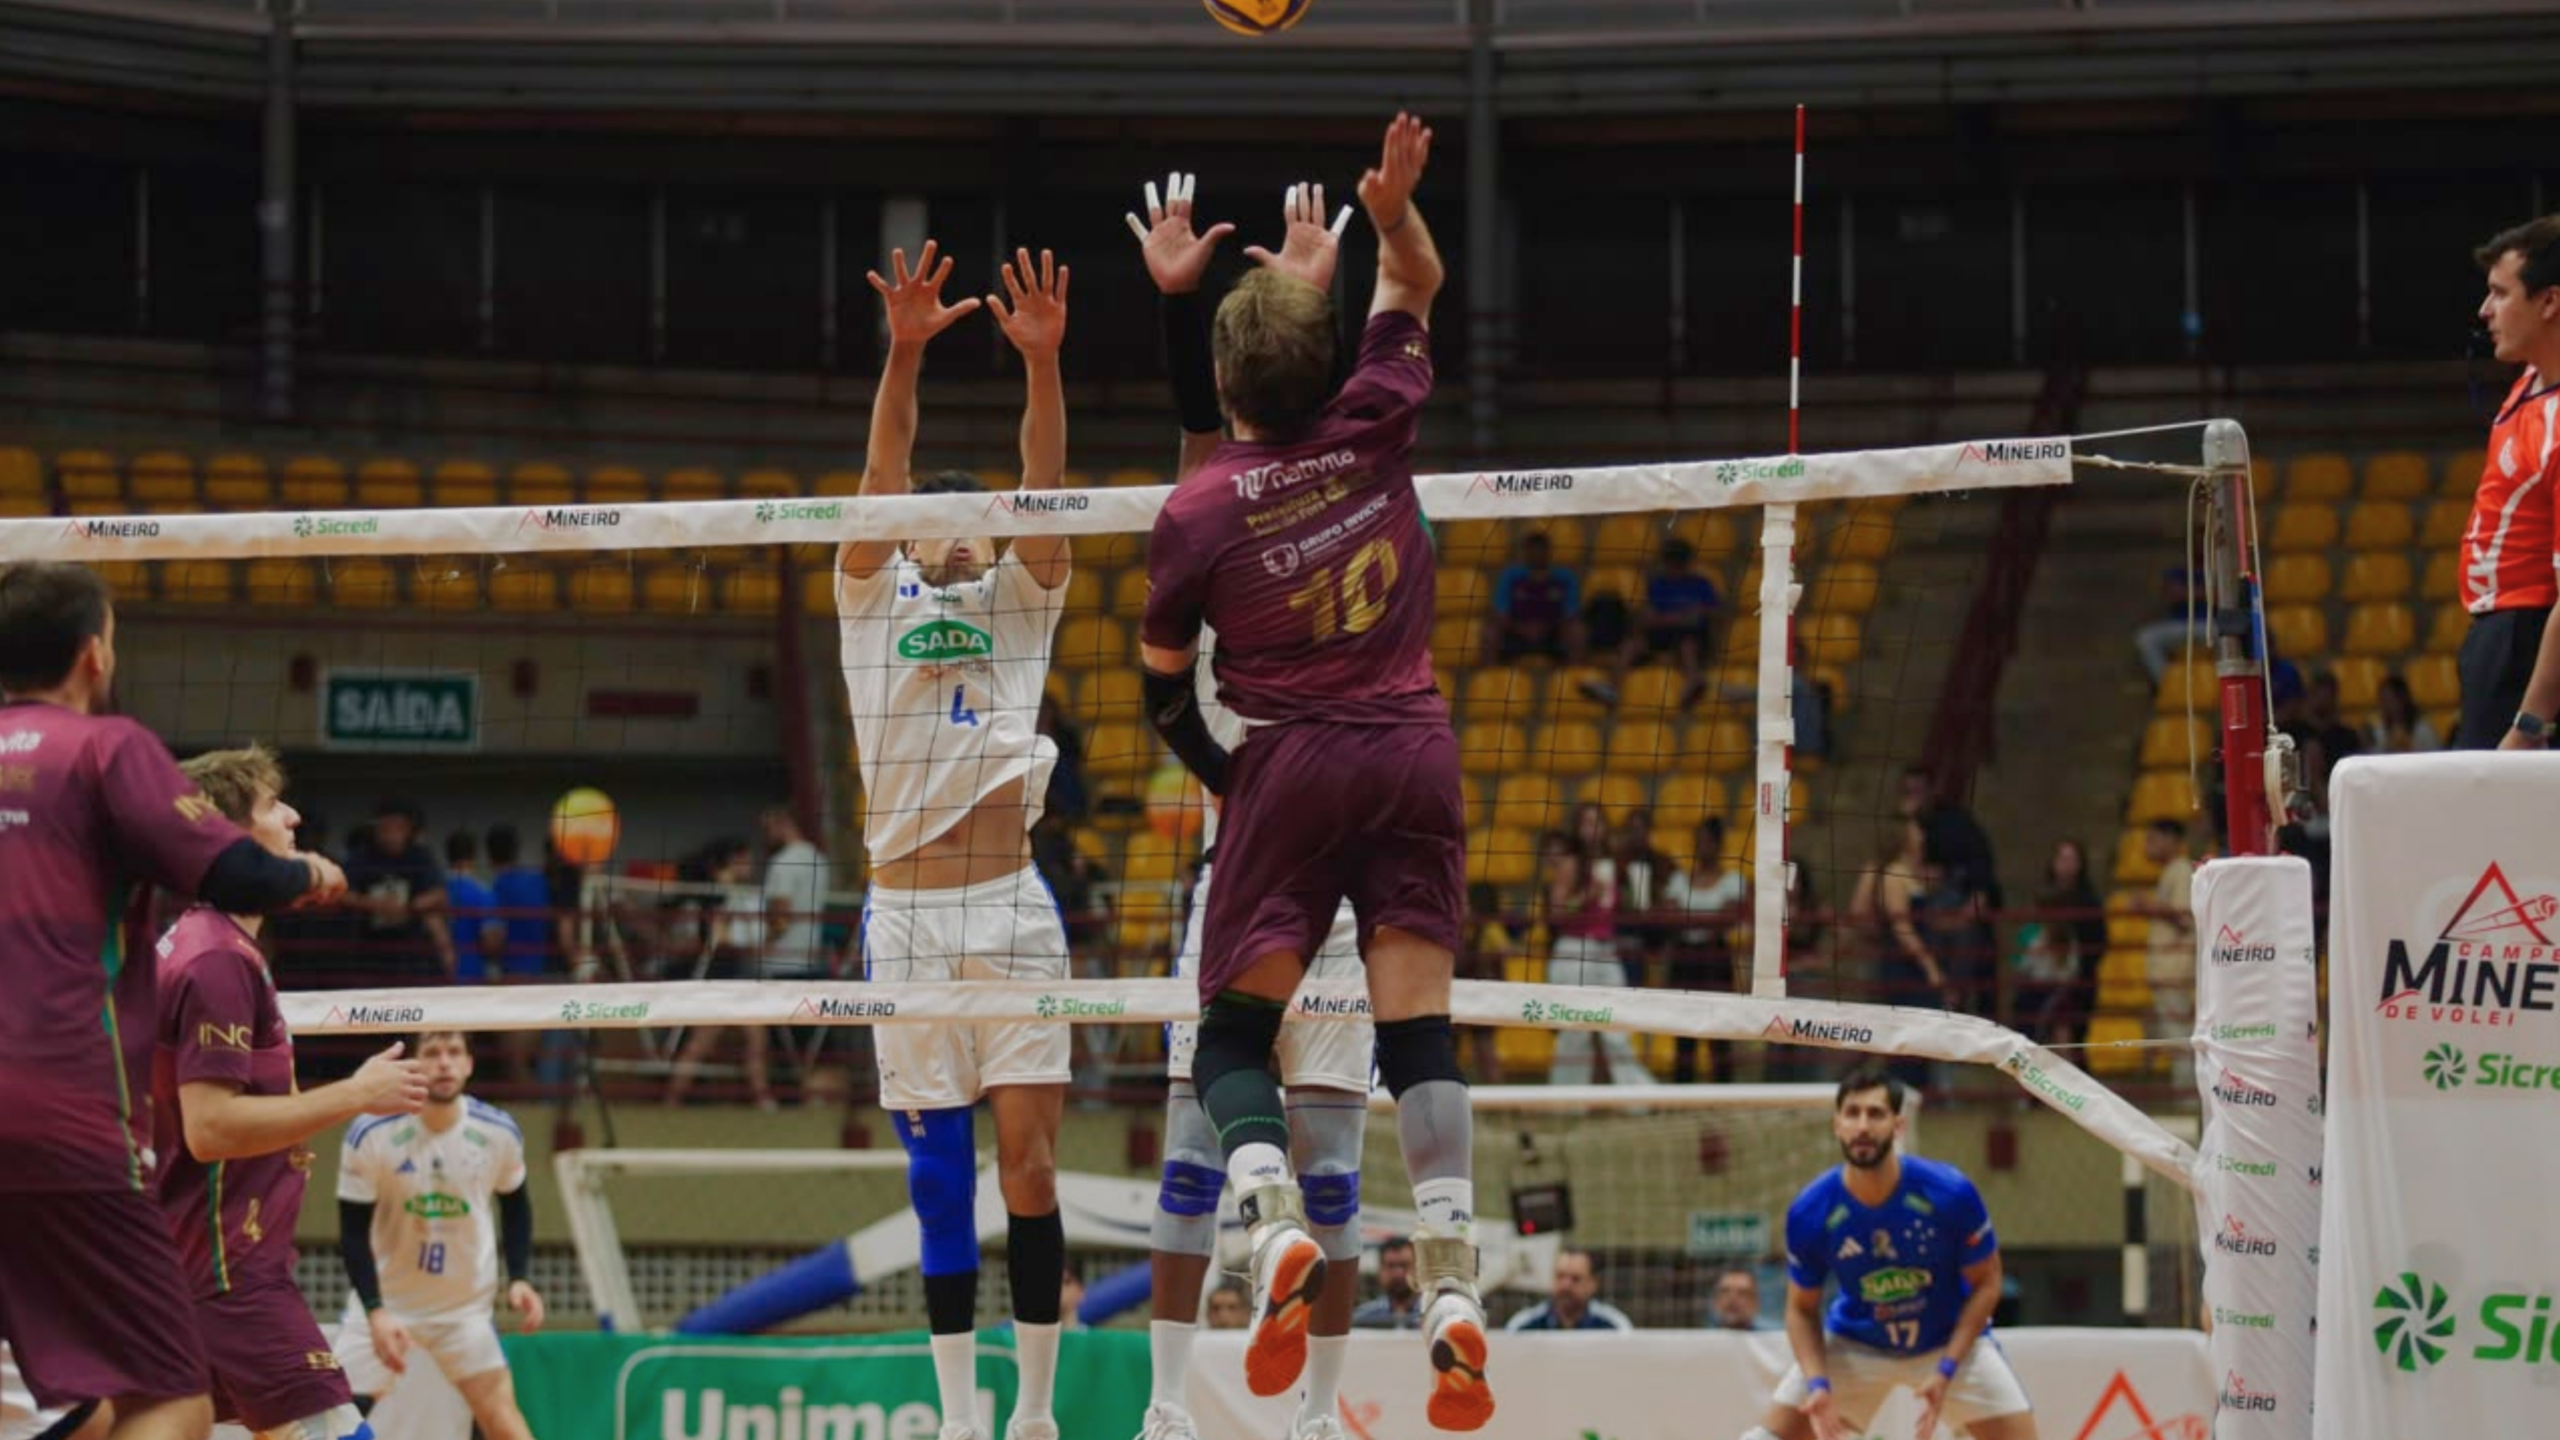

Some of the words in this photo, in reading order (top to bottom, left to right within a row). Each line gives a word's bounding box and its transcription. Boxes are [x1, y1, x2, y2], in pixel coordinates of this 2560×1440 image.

[1985, 443, 2065, 462] MINEIRO
[1741, 459, 1805, 480] Sicredi
[1495, 474, 1573, 493] MINEIRO
[780, 502, 842, 520] Sicredi
[1013, 495, 1088, 513] MINEIRO
[316, 517, 379, 535] Sicredi
[545, 509, 619, 527] MINEIRO
[87, 520, 160, 538] MINEIRO
[1299, 523, 1343, 551] GRUPO
[1289, 536, 1398, 642] 10
[906, 629, 988, 655] SADA
[950, 683, 979, 727] 4
[2380, 940, 2560, 1011] MINE
[348, 1006, 424, 1023] MINEIRO
[586, 1002, 649, 1019] Sicredi
[820, 1000, 895, 1017] MINEIRO
[1061, 999, 1125, 1015] Sicredi
[1547, 1003, 1612, 1024] Sicredi
[2386, 1004, 2418, 1020] DE
[2432, 1007, 2515, 1027] VOLEI
[1791, 1019, 1872, 1043] MINEIRO
[2220, 1023, 2276, 1039] Sicredi
[2024, 1066, 2087, 1111] Sicredi
[243, 1198, 262, 1242] 4
[418, 1241, 445, 1275] 18
[1885, 1319, 1919, 1348] 17
